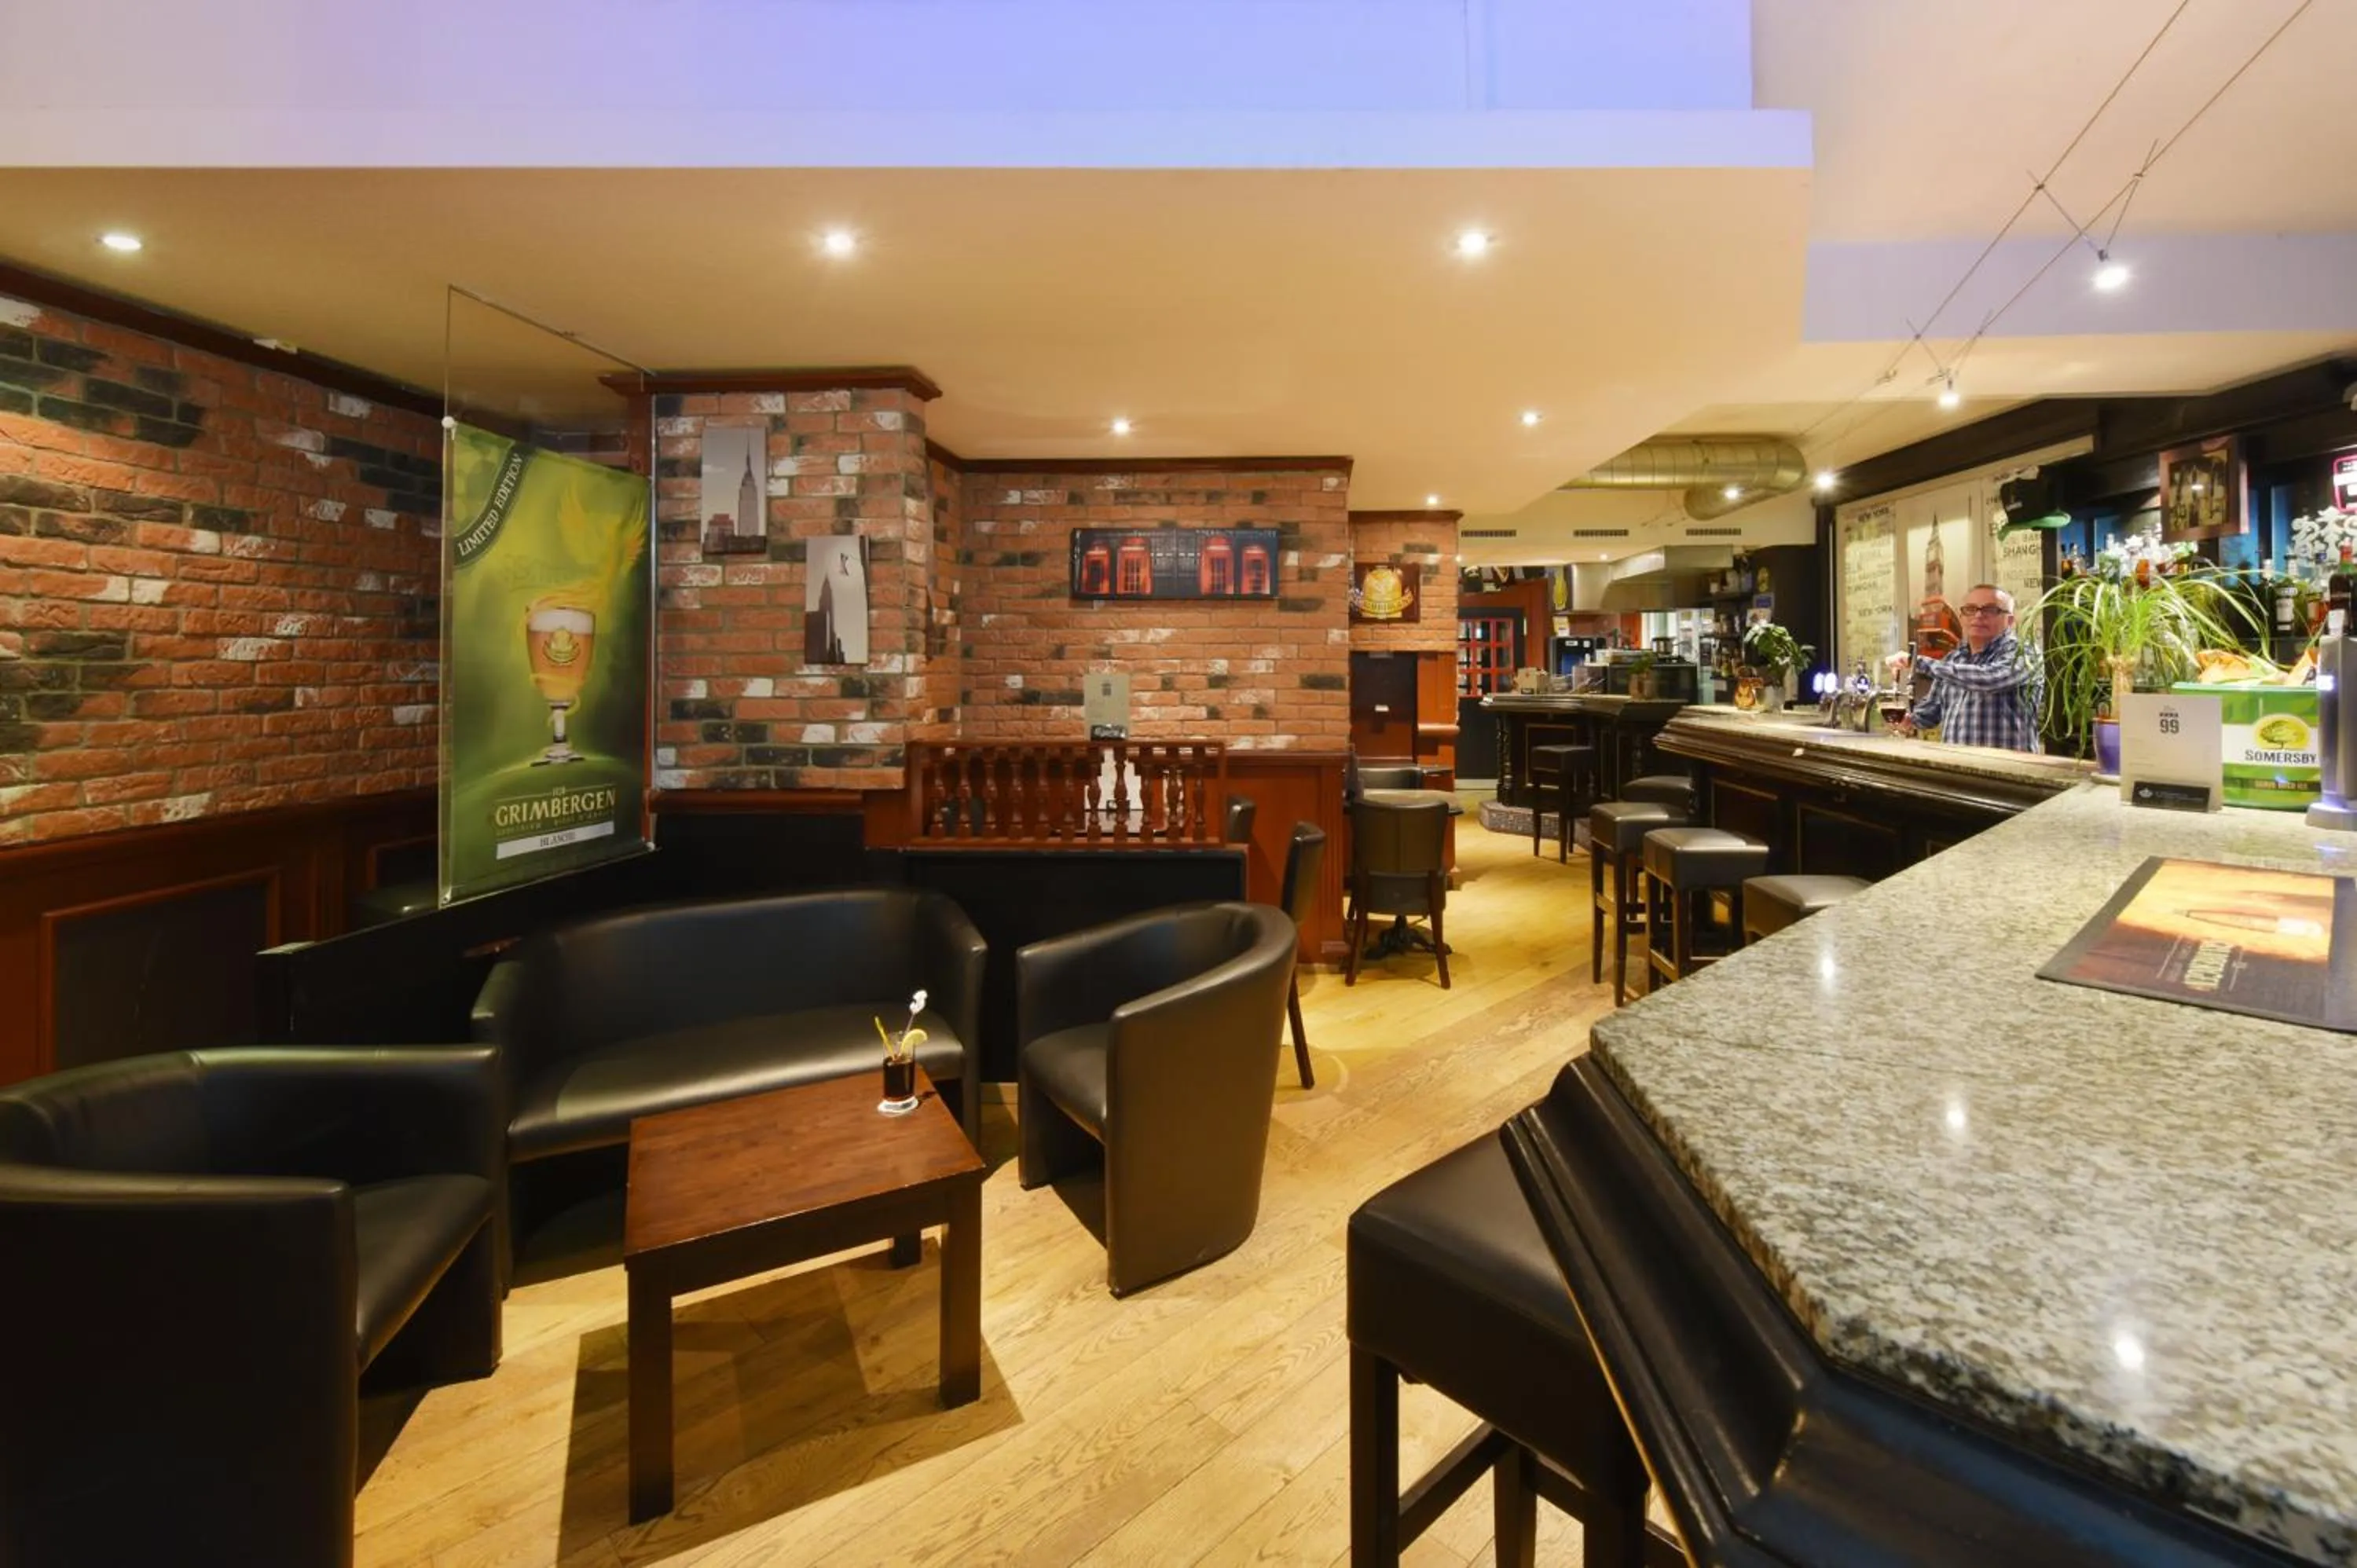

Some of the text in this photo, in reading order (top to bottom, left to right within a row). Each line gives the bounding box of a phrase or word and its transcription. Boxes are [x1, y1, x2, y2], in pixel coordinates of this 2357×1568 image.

[458, 452, 523, 556] LIMITED EDITION
[2160, 719, 2179, 734] 99
[2245, 749, 2317, 764] SOMERSBY
[496, 789, 615, 826] GRIMBERGEN
